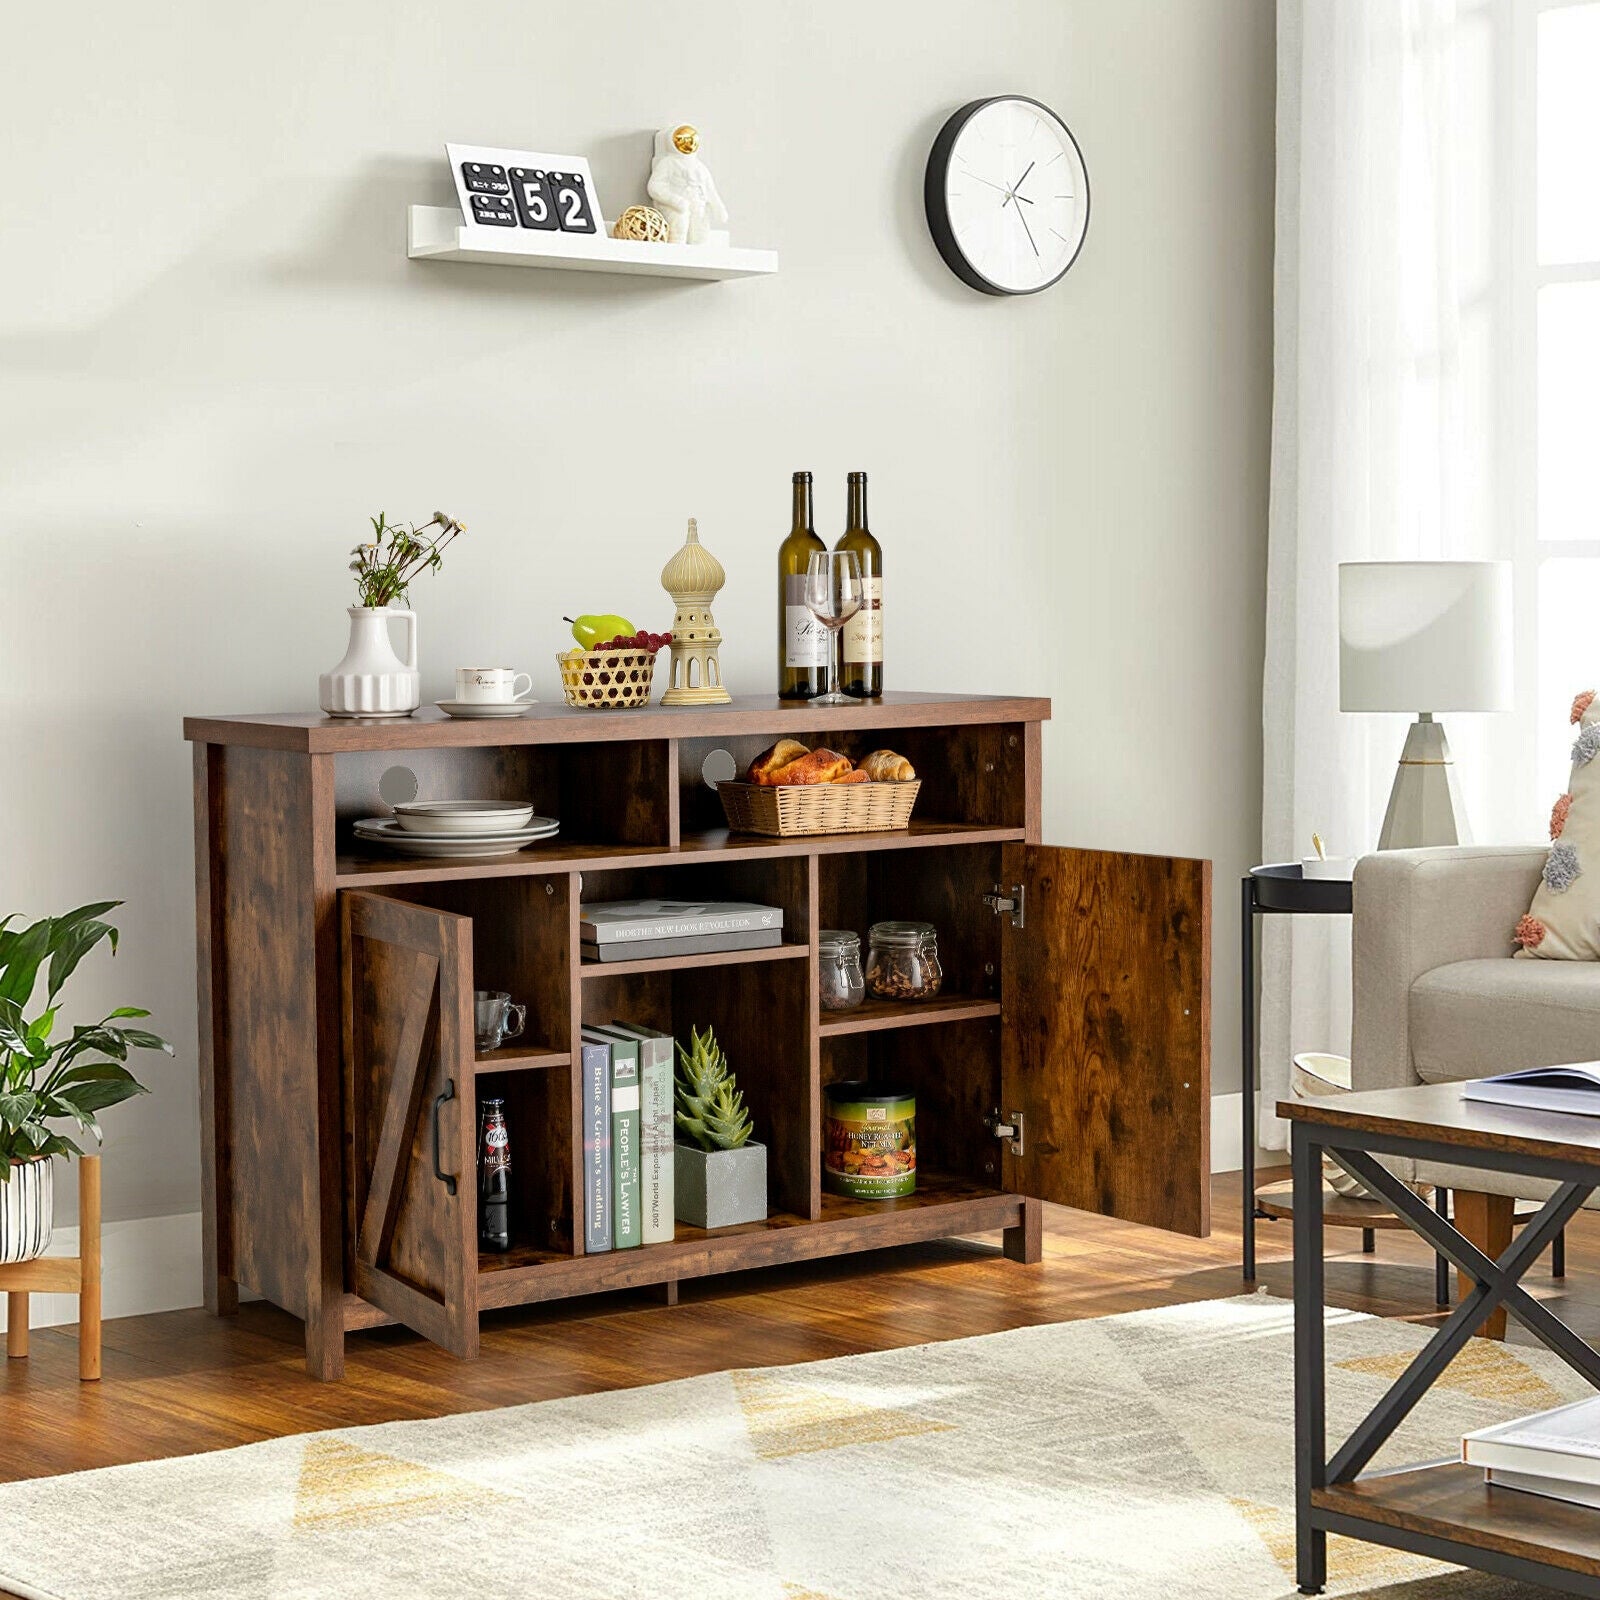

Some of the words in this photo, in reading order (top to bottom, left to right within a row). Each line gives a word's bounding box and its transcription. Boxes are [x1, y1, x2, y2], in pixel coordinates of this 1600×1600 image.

[594, 1067, 603, 1101] Bride
[652, 1080, 661, 1108] Japan
[594, 1105, 602, 1116] &
[594, 1120, 603, 1174] Groom's
[619, 1118, 631, 1180] PEOPLE'S
[652, 1134, 661, 1180] Exposition
[848, 1132, 871, 1140] HONEY
[594, 1178, 604, 1229] wedding
[620, 1182, 631, 1235] LAWYER
